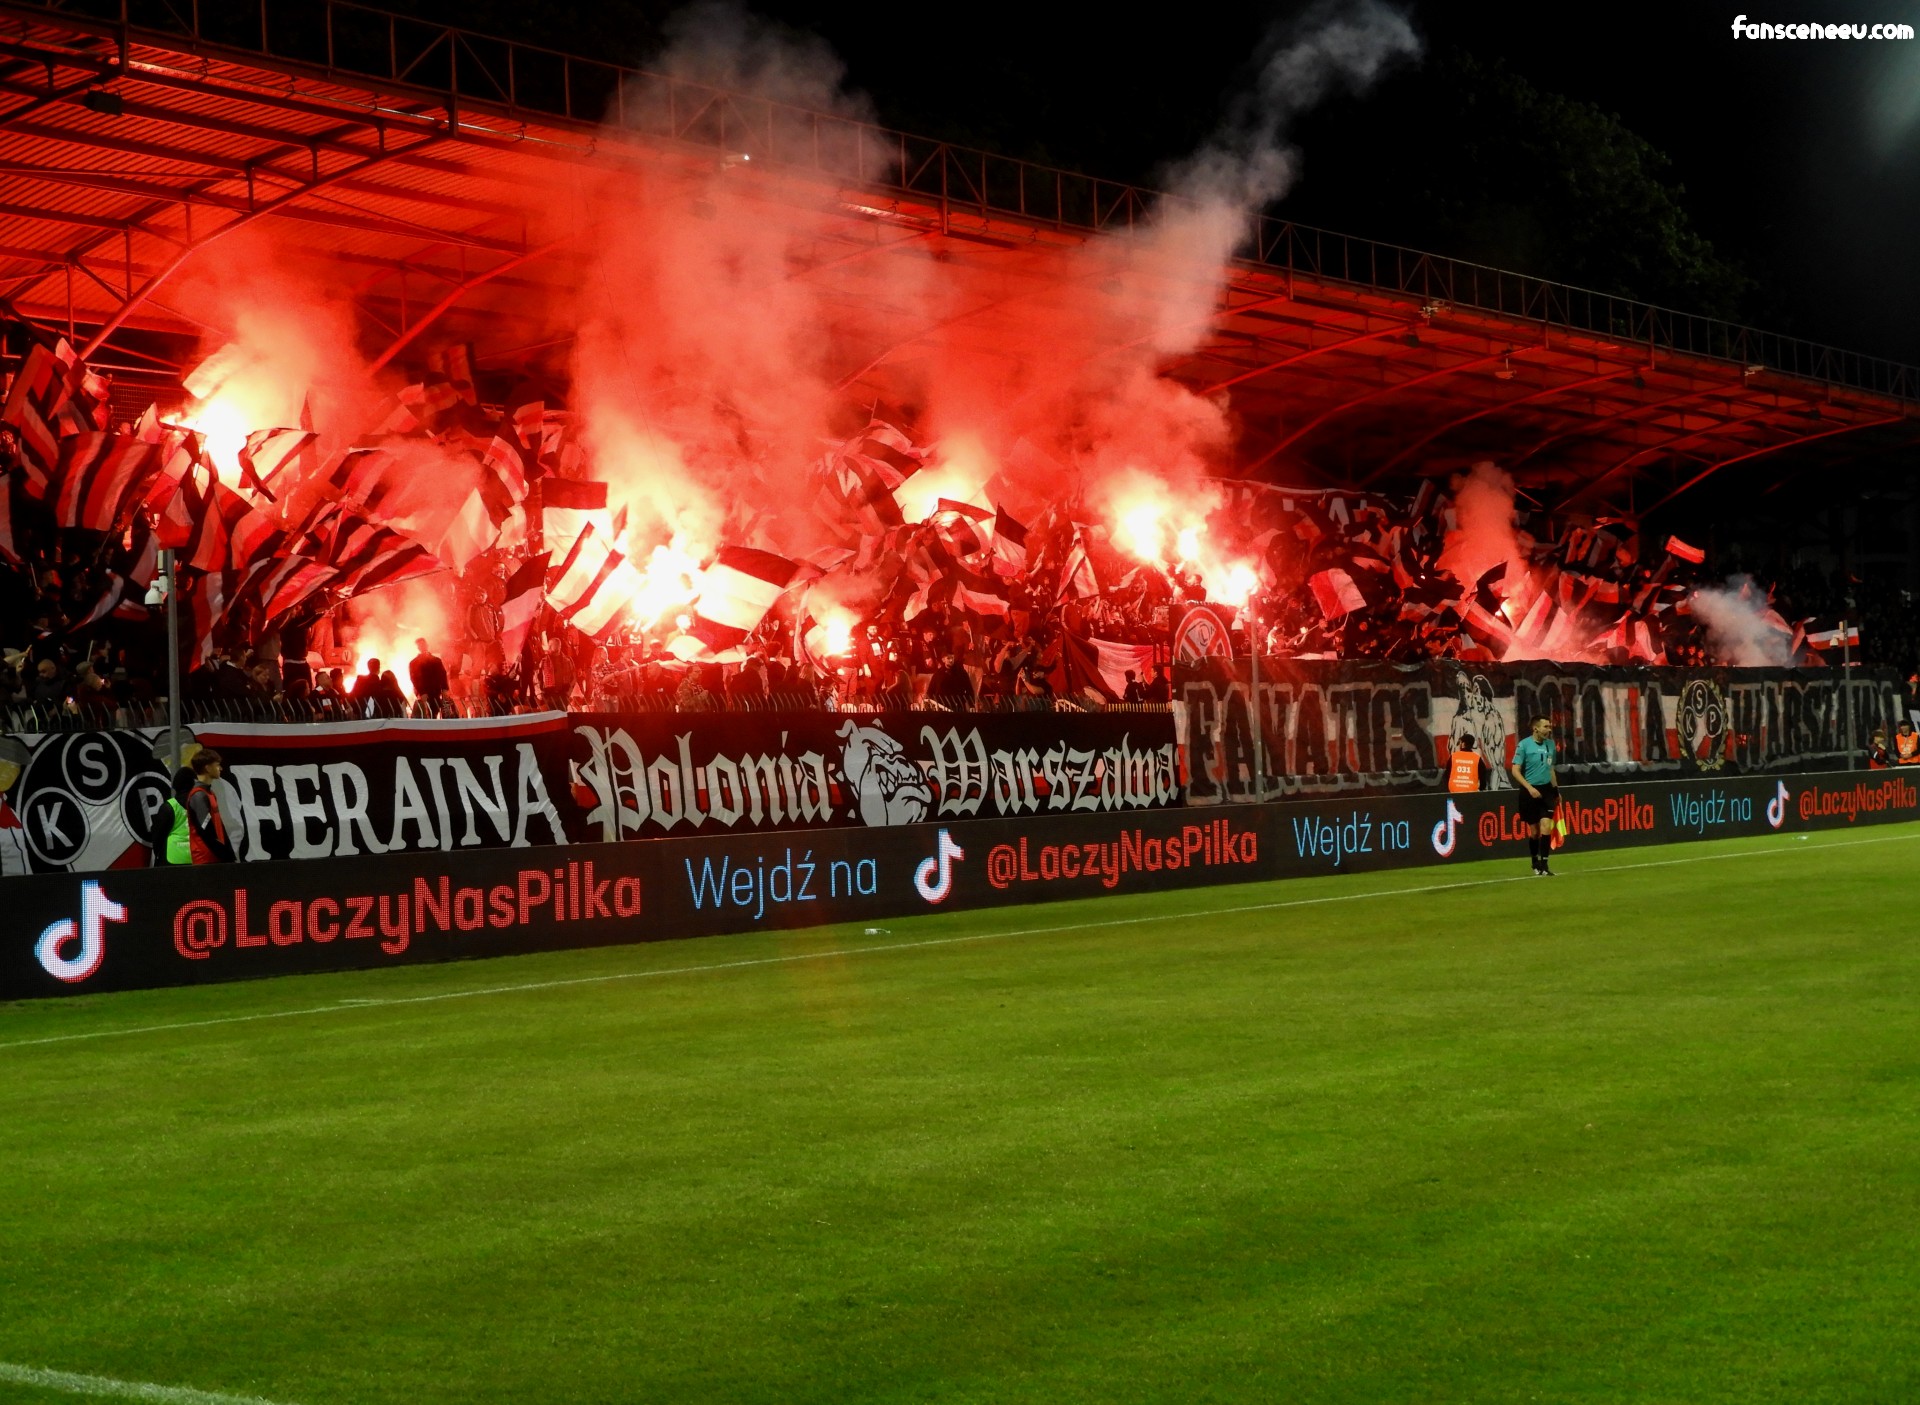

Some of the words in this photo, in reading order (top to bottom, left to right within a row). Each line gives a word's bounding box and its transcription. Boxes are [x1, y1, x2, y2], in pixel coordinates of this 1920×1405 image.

[1183, 680, 1447, 807] FANATICS
[574, 725, 834, 842] Polonia
[920, 725, 1180, 817] Warszawa
[1671, 789, 1726, 834] Wejdź
[1731, 797, 1752, 822] na
[1799, 777, 1917, 822] @LaczyNasPilka
[987, 820, 1258, 889] @LaczyNasPilka
[1293, 812, 1372, 866] Wejdź
[1382, 818, 1410, 849] na
[173, 861, 641, 959] @LaczyNasPilka
[685, 848, 817, 920] Wejdź
[831, 859, 877, 897] na
